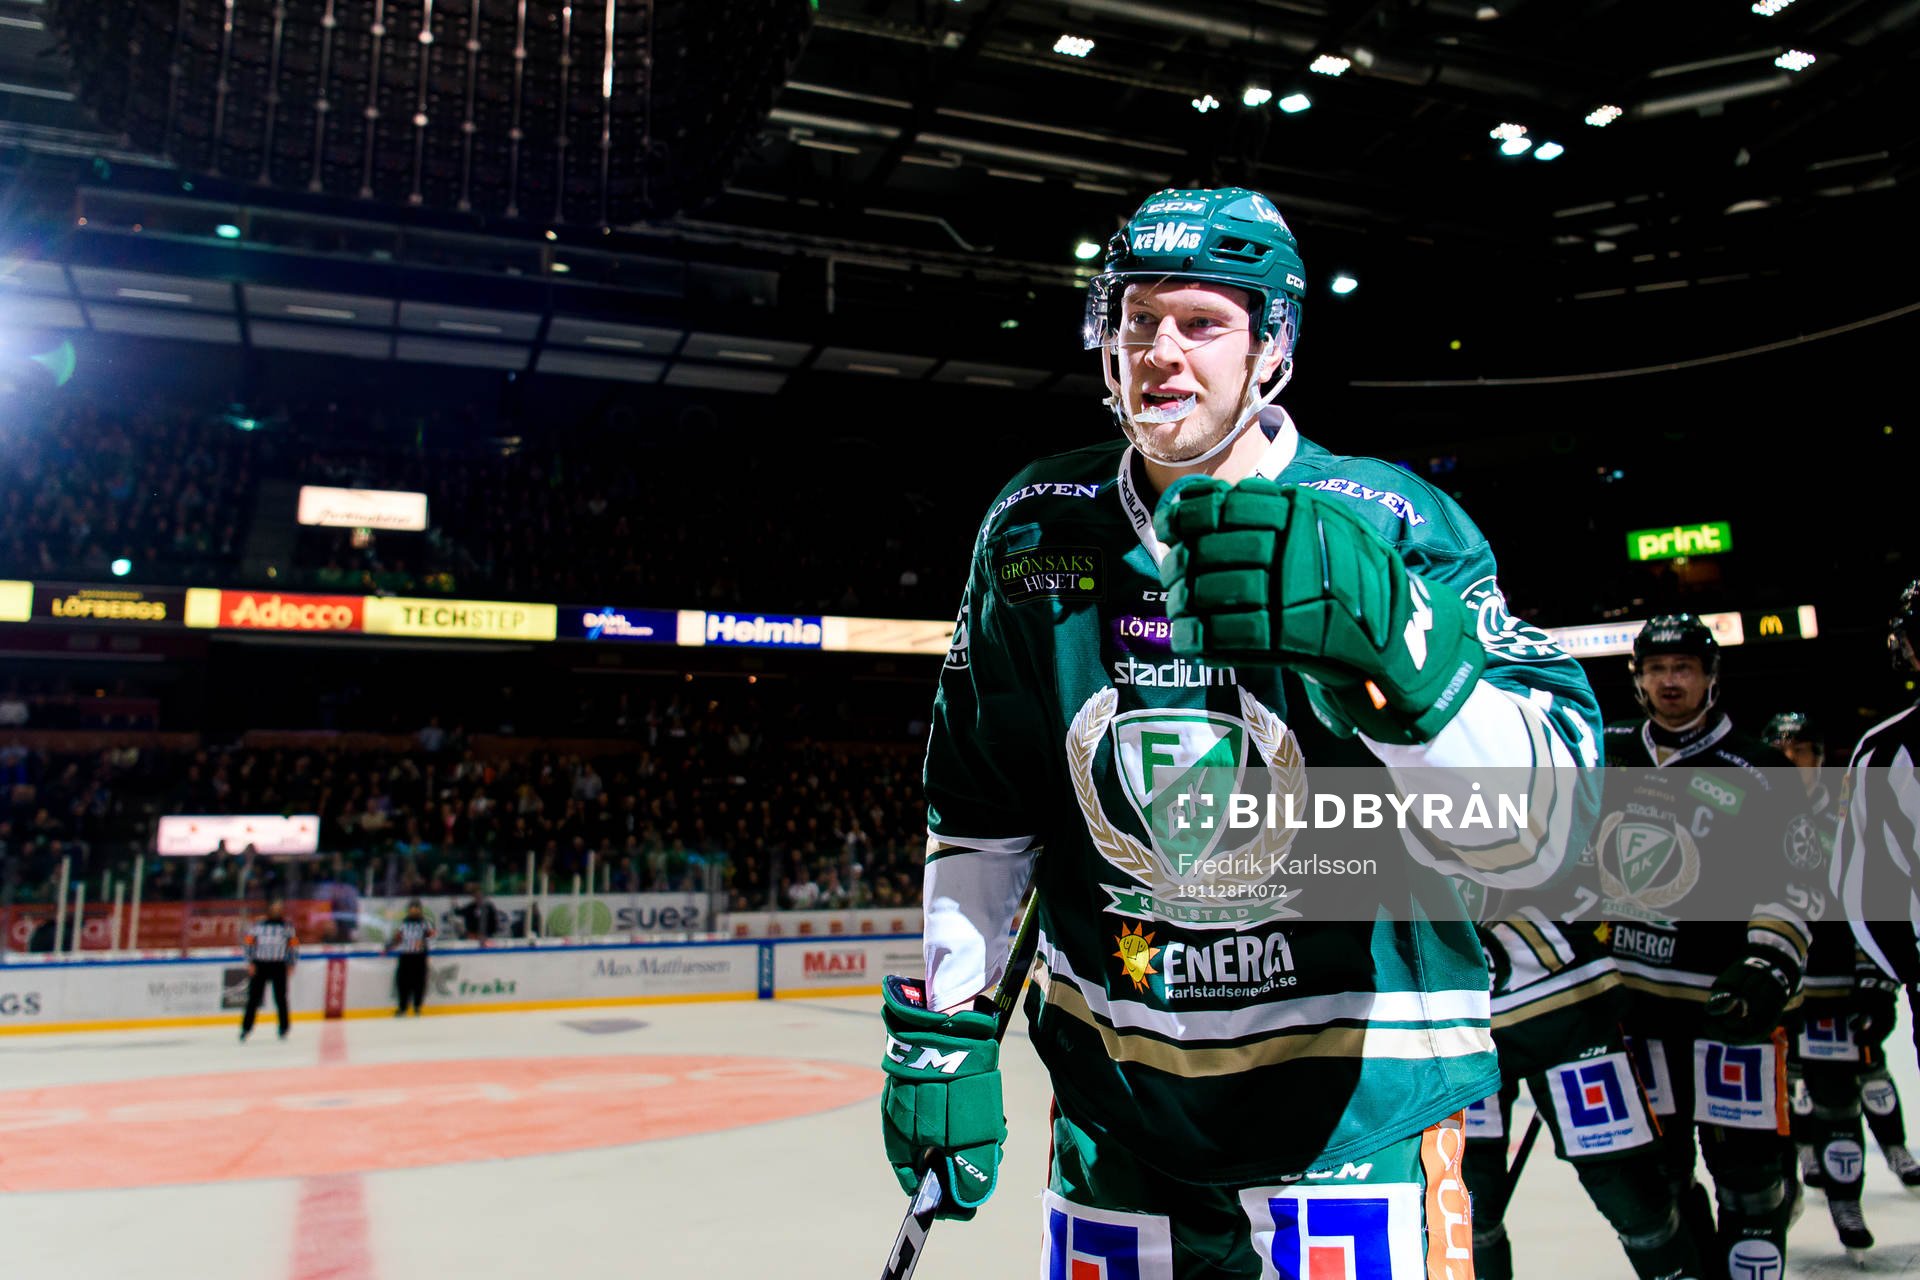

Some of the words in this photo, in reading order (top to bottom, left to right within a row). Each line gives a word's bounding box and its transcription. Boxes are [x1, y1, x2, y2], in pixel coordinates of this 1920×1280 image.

[1133, 221, 1202, 252] KEWAB
[1121, 468, 1148, 530] stadium
[1638, 524, 1721, 560] print
[1001, 554, 1094, 581] GRÖNSAKS
[231, 596, 353, 630] Adecco
[1120, 616, 1174, 638] LÖFB
[707, 615, 821, 645] Helmia
[1114, 656, 1237, 688] stadium
[1690, 776, 1737, 807] coop
[1139, 896, 1250, 921] KARLSTAD
[1613, 924, 1676, 957] ENERGI
[803, 950, 866, 973] MAXI
[1164, 976, 1297, 1000] karlstadsenergi.se
[954, 1155, 988, 1183] CCM
